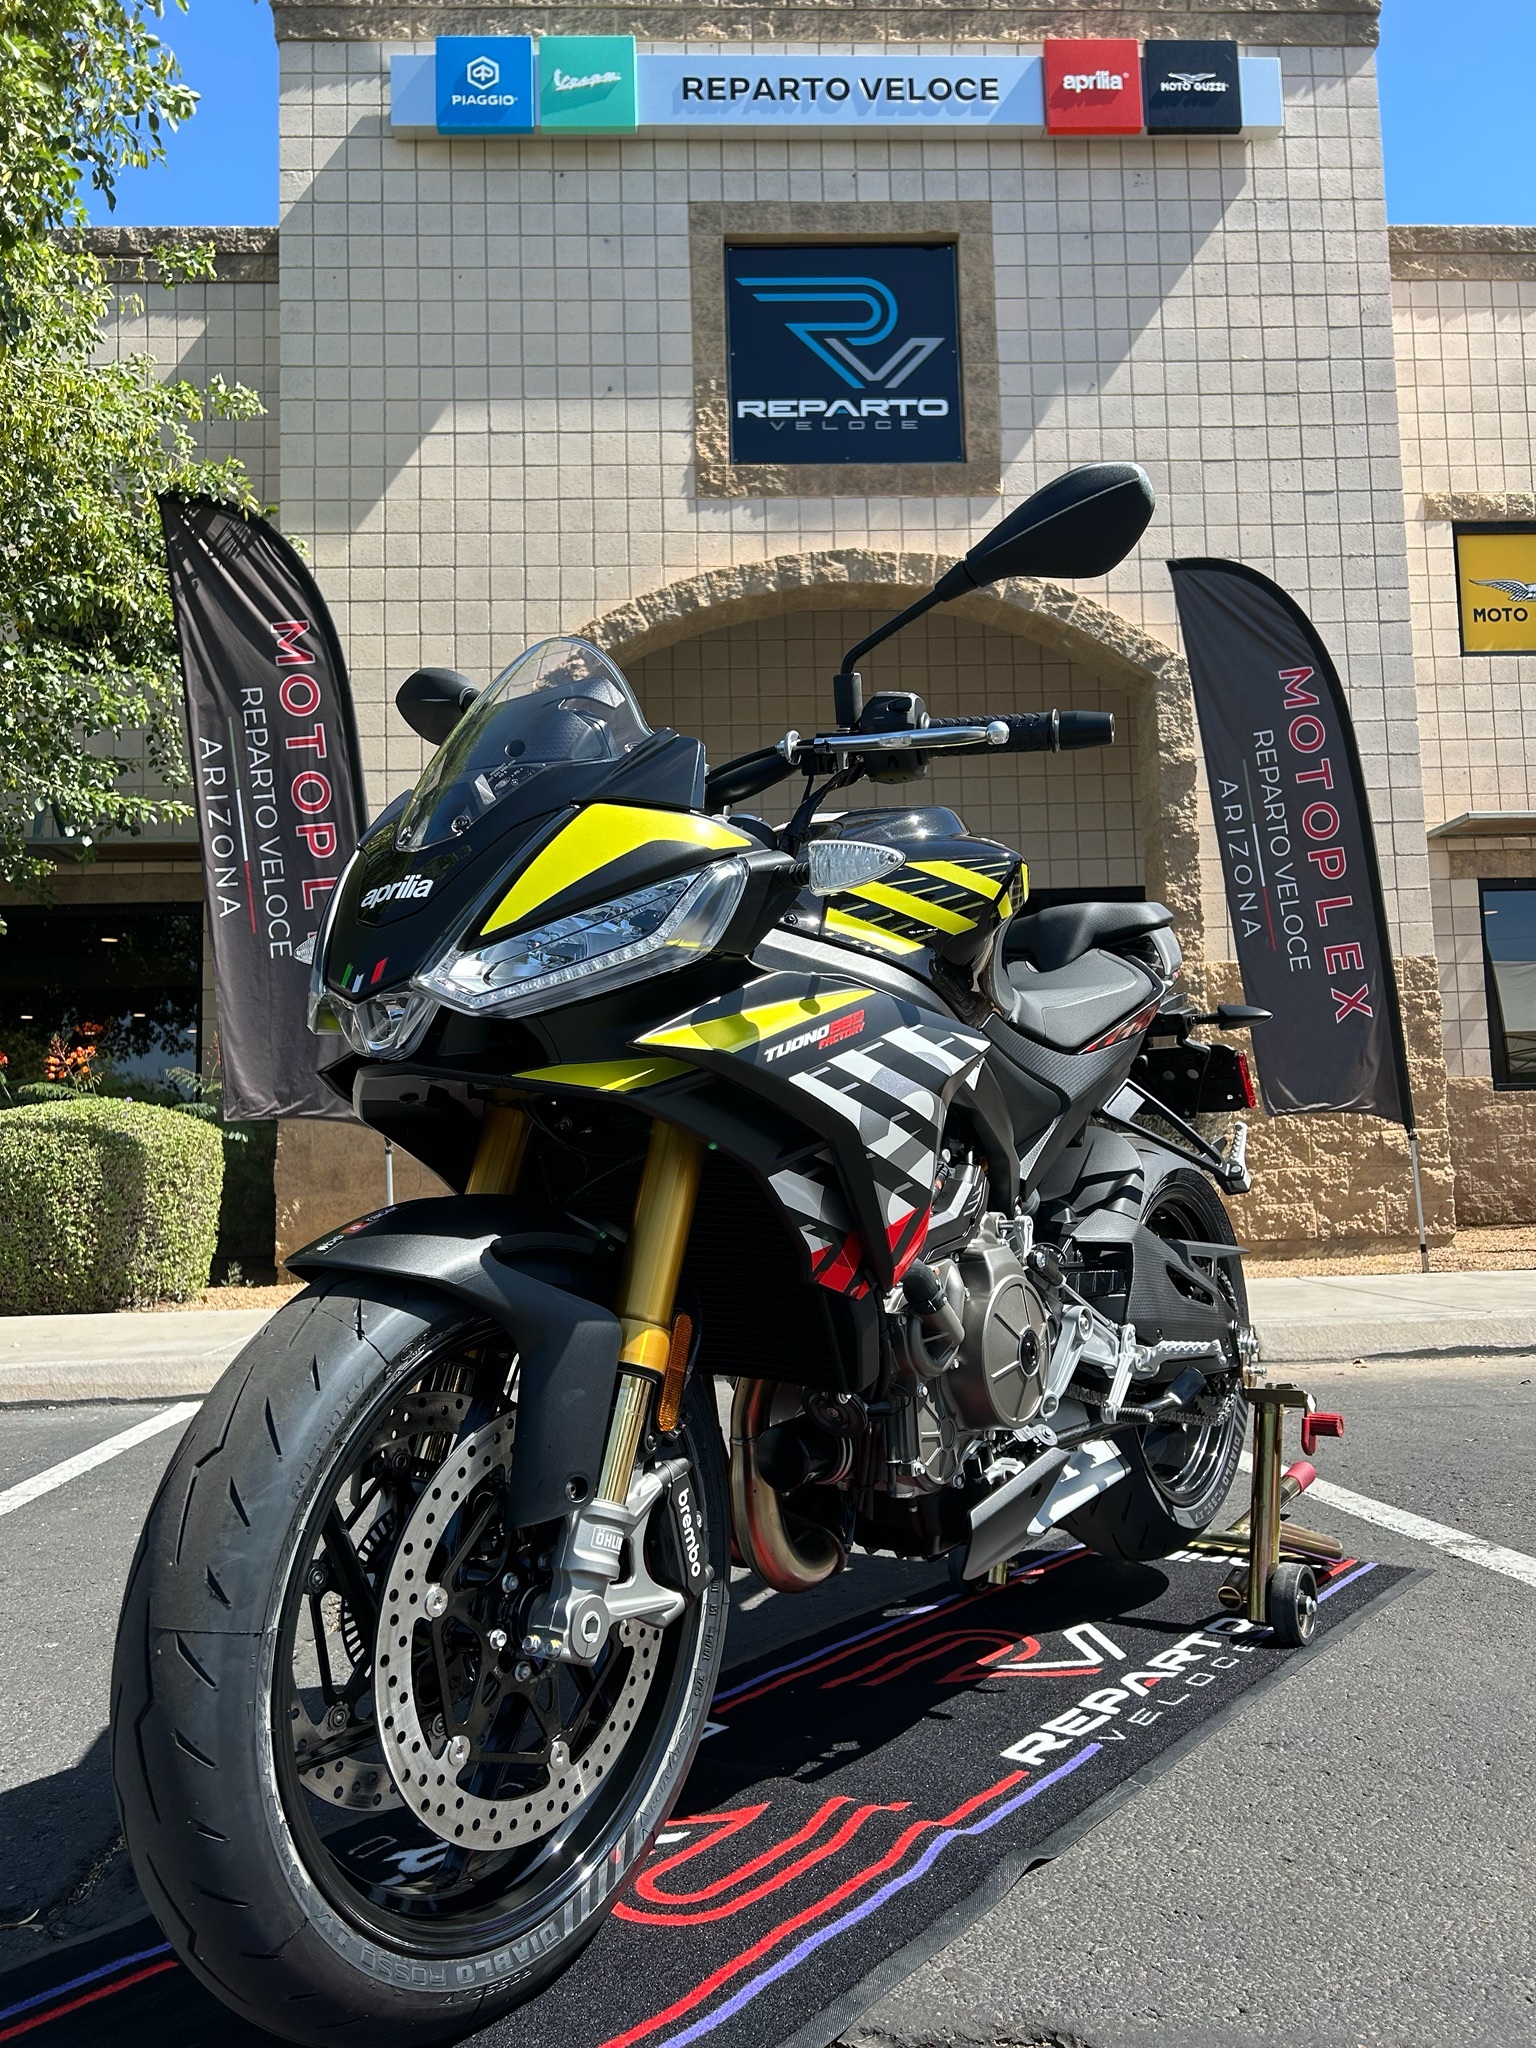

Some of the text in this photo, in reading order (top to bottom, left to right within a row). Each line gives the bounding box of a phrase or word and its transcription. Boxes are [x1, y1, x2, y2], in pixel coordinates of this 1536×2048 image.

[451, 94, 516, 106] PIAGGIO
[681, 77, 999, 101] REPARTO VELOCE
[1063, 70, 1124, 93] aprilia
[1160, 81, 1226, 92] MOTO GUZZI
[737, 399, 949, 418] REPARTO
[769, 420, 919, 431] VELOCE
[1473, 607, 1528, 623] MOTO
[199, 736, 241, 918] ARIZONA
[240, 687, 293, 959] REPARTO VELOCE
[1218, 779, 1261, 938] ARIZONA
[1253, 729, 1311, 972] REPARTO VELOCE
[1278, 666, 1373, 1024] MOTOPLEX
[360, 874, 434, 909] aprilia
[764, 1024, 830, 1063] TUONO
[818, 1022, 865, 1050] FACTORY
[678, 1487, 701, 1578] brembo
[1000, 1617, 1254, 1766] REPARTO
[1098, 1640, 1262, 1741] VELOCE
[314, 1913, 562, 1987] DIABLO ROSSO IV
